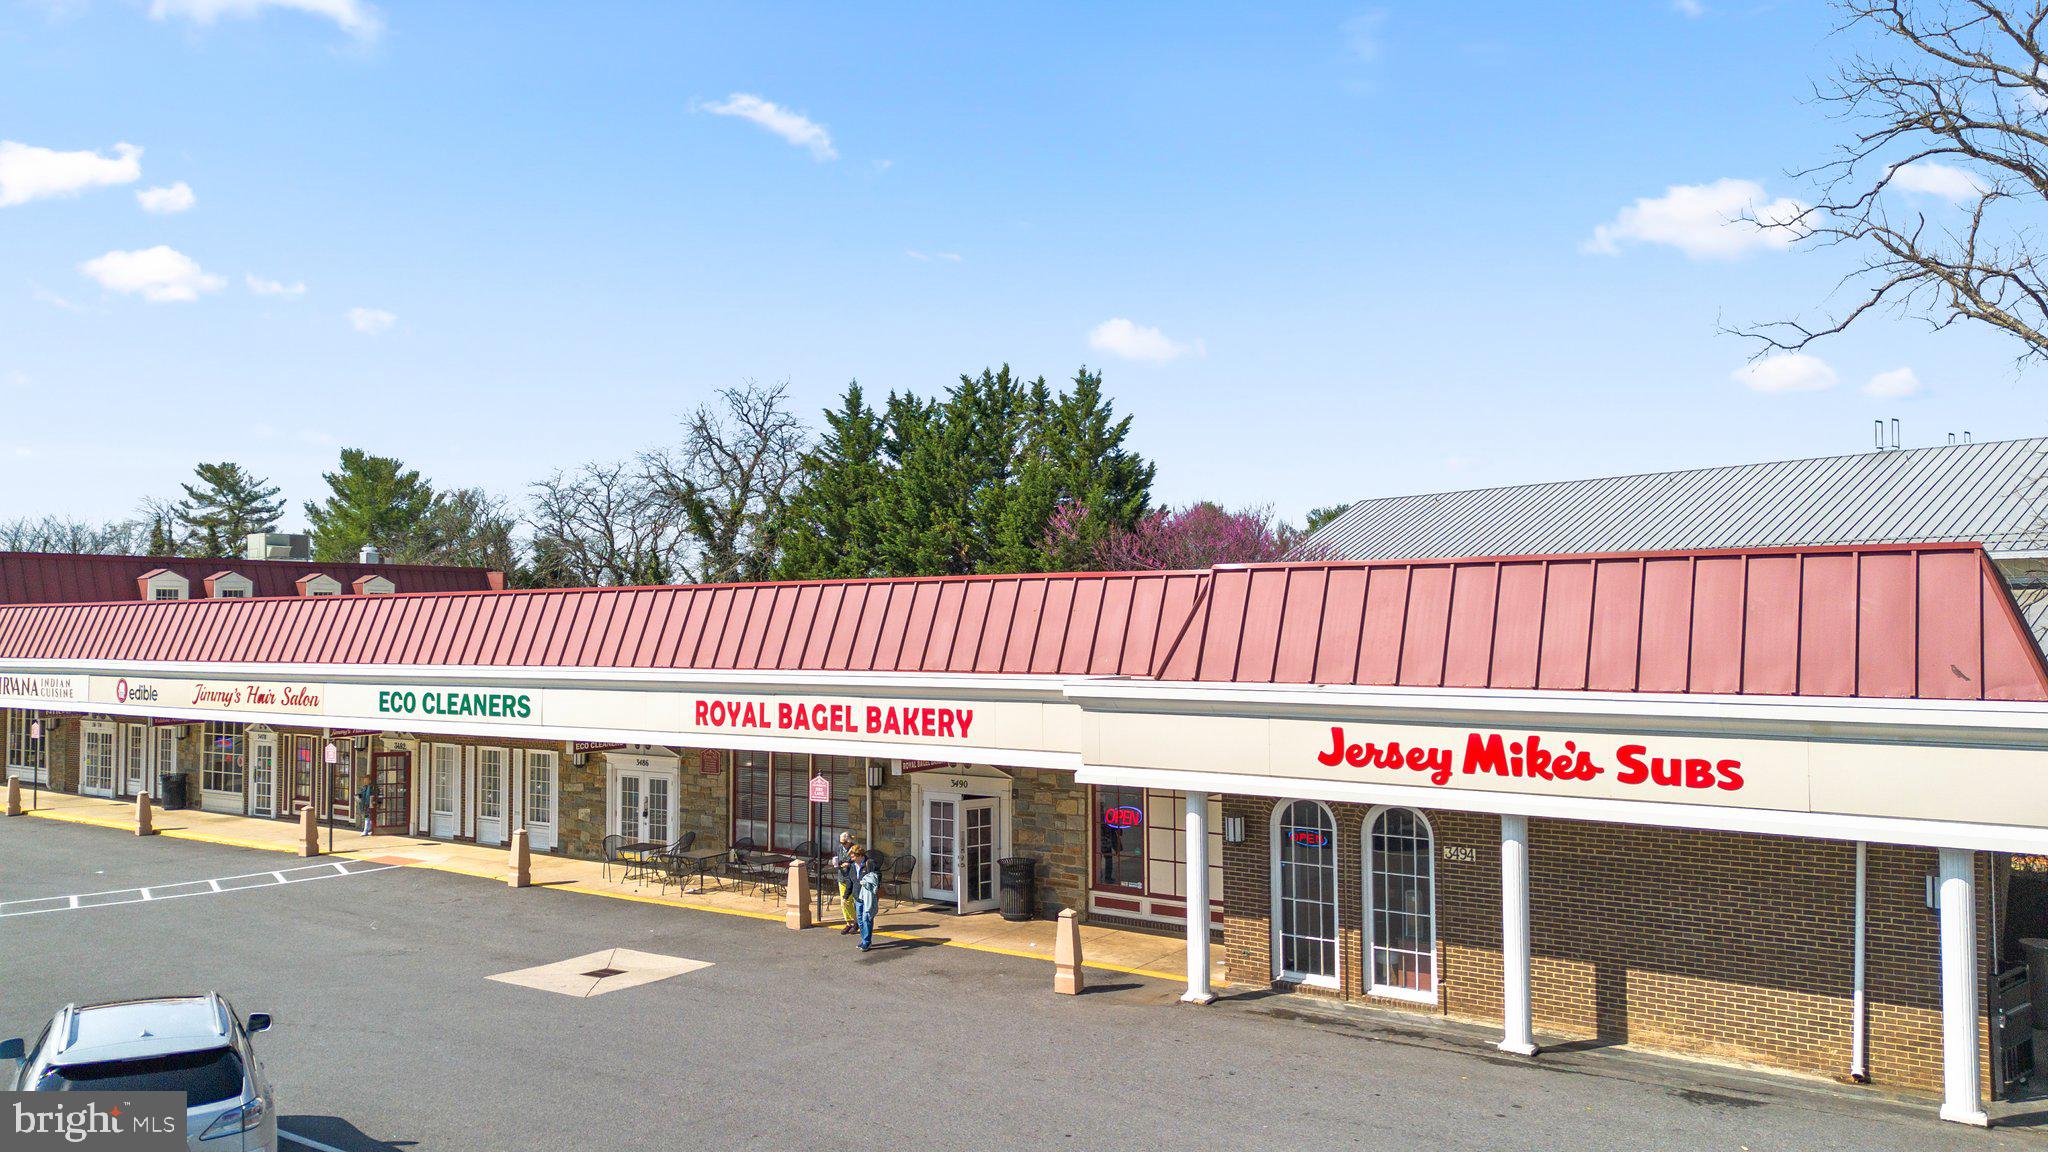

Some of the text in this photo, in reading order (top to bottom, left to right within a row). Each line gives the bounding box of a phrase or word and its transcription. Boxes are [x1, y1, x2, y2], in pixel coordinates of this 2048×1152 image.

[41, 678, 71, 688] INDIAN
[41, 688, 74, 699] CUISINE
[129, 684, 158, 701] edible
[192, 684, 319, 707] Jimmy's Hair Salon
[379, 691, 531, 718] ECO CLEANERS
[696, 700, 974, 738] ROYAL BAGEL BAKERY
[1318, 727, 1745, 791] Jersey Mike's SUBS
[951, 779, 968, 788] 3490
[1105, 808, 1140, 826] OPEN
[1290, 832, 1324, 845] OPEN
[1445, 846, 1474, 862] 3494
